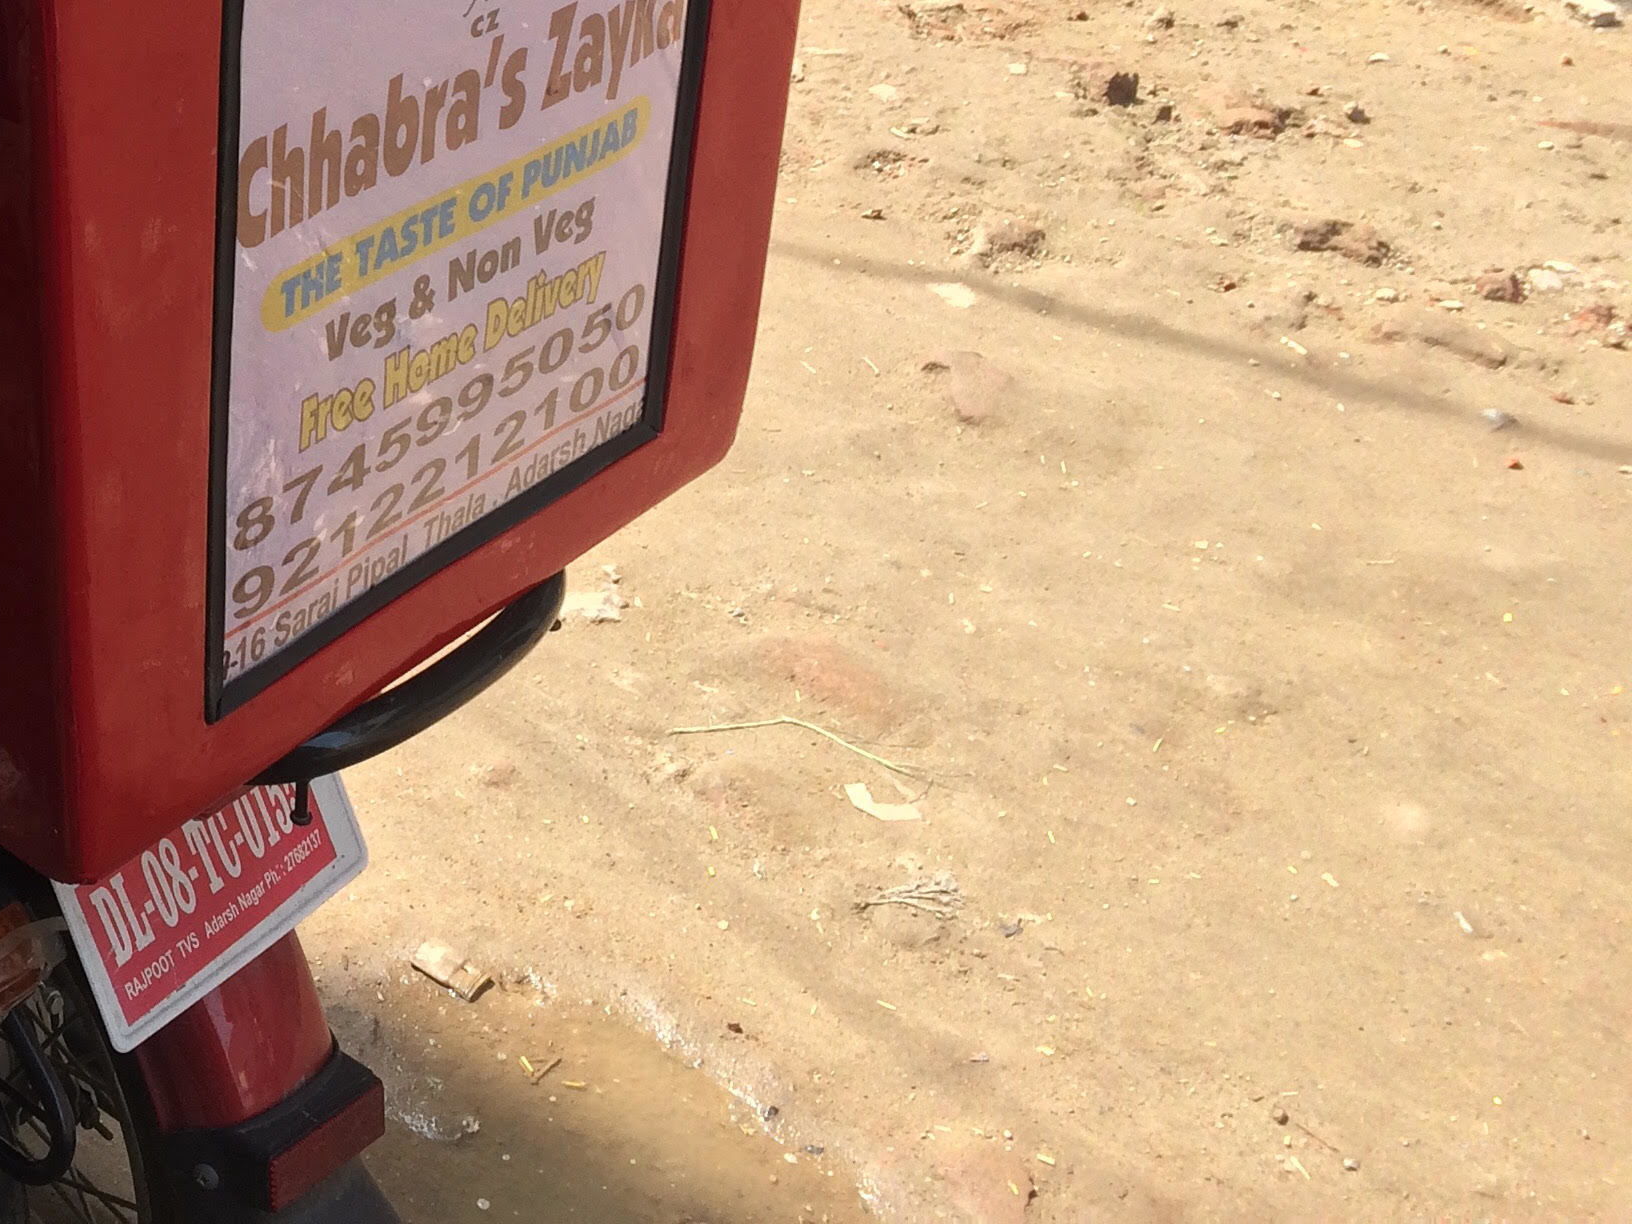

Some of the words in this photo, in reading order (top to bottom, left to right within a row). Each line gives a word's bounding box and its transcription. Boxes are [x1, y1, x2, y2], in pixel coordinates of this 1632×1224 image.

[470, 9, 500, 38] CZ
[236, 35, 529, 248] Chhabra's
[280, 258, 342, 317] THE
[355, 202, 456, 271] TASTE
[468, 172, 513, 223] OF
[520, 107, 638, 198] PUNJAB
[298, 377, 375, 453] Free
[383, 325, 475, 408] Home
[484, 251, 607, 351] Delivery
[325, 298, 396, 361] Veg
[408, 274, 436, 321] &
[448, 240, 521, 301] Non
[533, 195, 596, 255] Veg
[232, 344, 640, 620] 9212212100
[233, 283, 645, 551] 8745995050
[274, 578, 339, 647] Sarai
[346, 534, 408, 601] Pipal
[505, 428, 586, 501] Adarsh
[124, 949, 175, 1000] RAJPOOT
[176, 932, 200, 958] TVS
[204, 902, 240, 939] Adarsh
[237, 881, 266, 911] Nagar
[284, 829, 322, 872] 27682137
